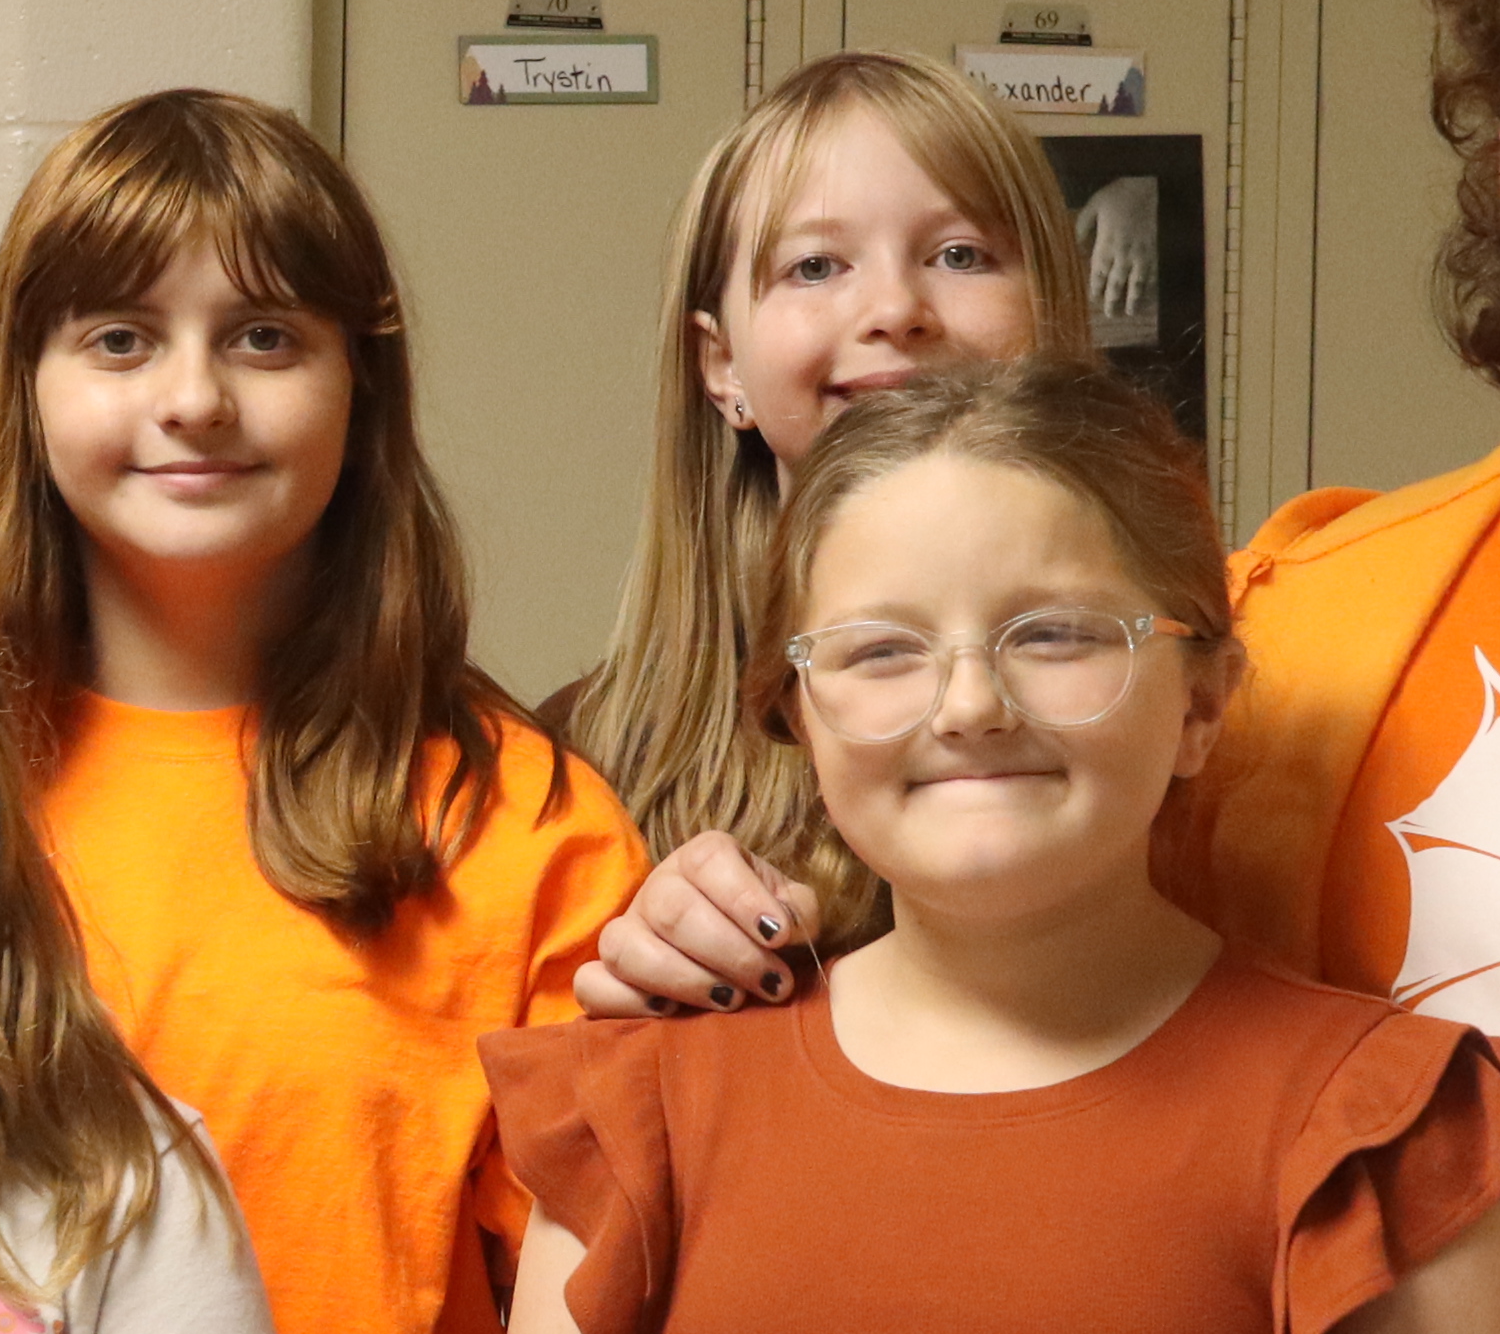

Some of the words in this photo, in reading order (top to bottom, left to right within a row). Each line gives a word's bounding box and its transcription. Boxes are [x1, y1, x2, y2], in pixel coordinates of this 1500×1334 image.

[1035, 10, 1059, 29] 69
[514, 57, 612, 92] Trystin
[969, 71, 1092, 103] exander
